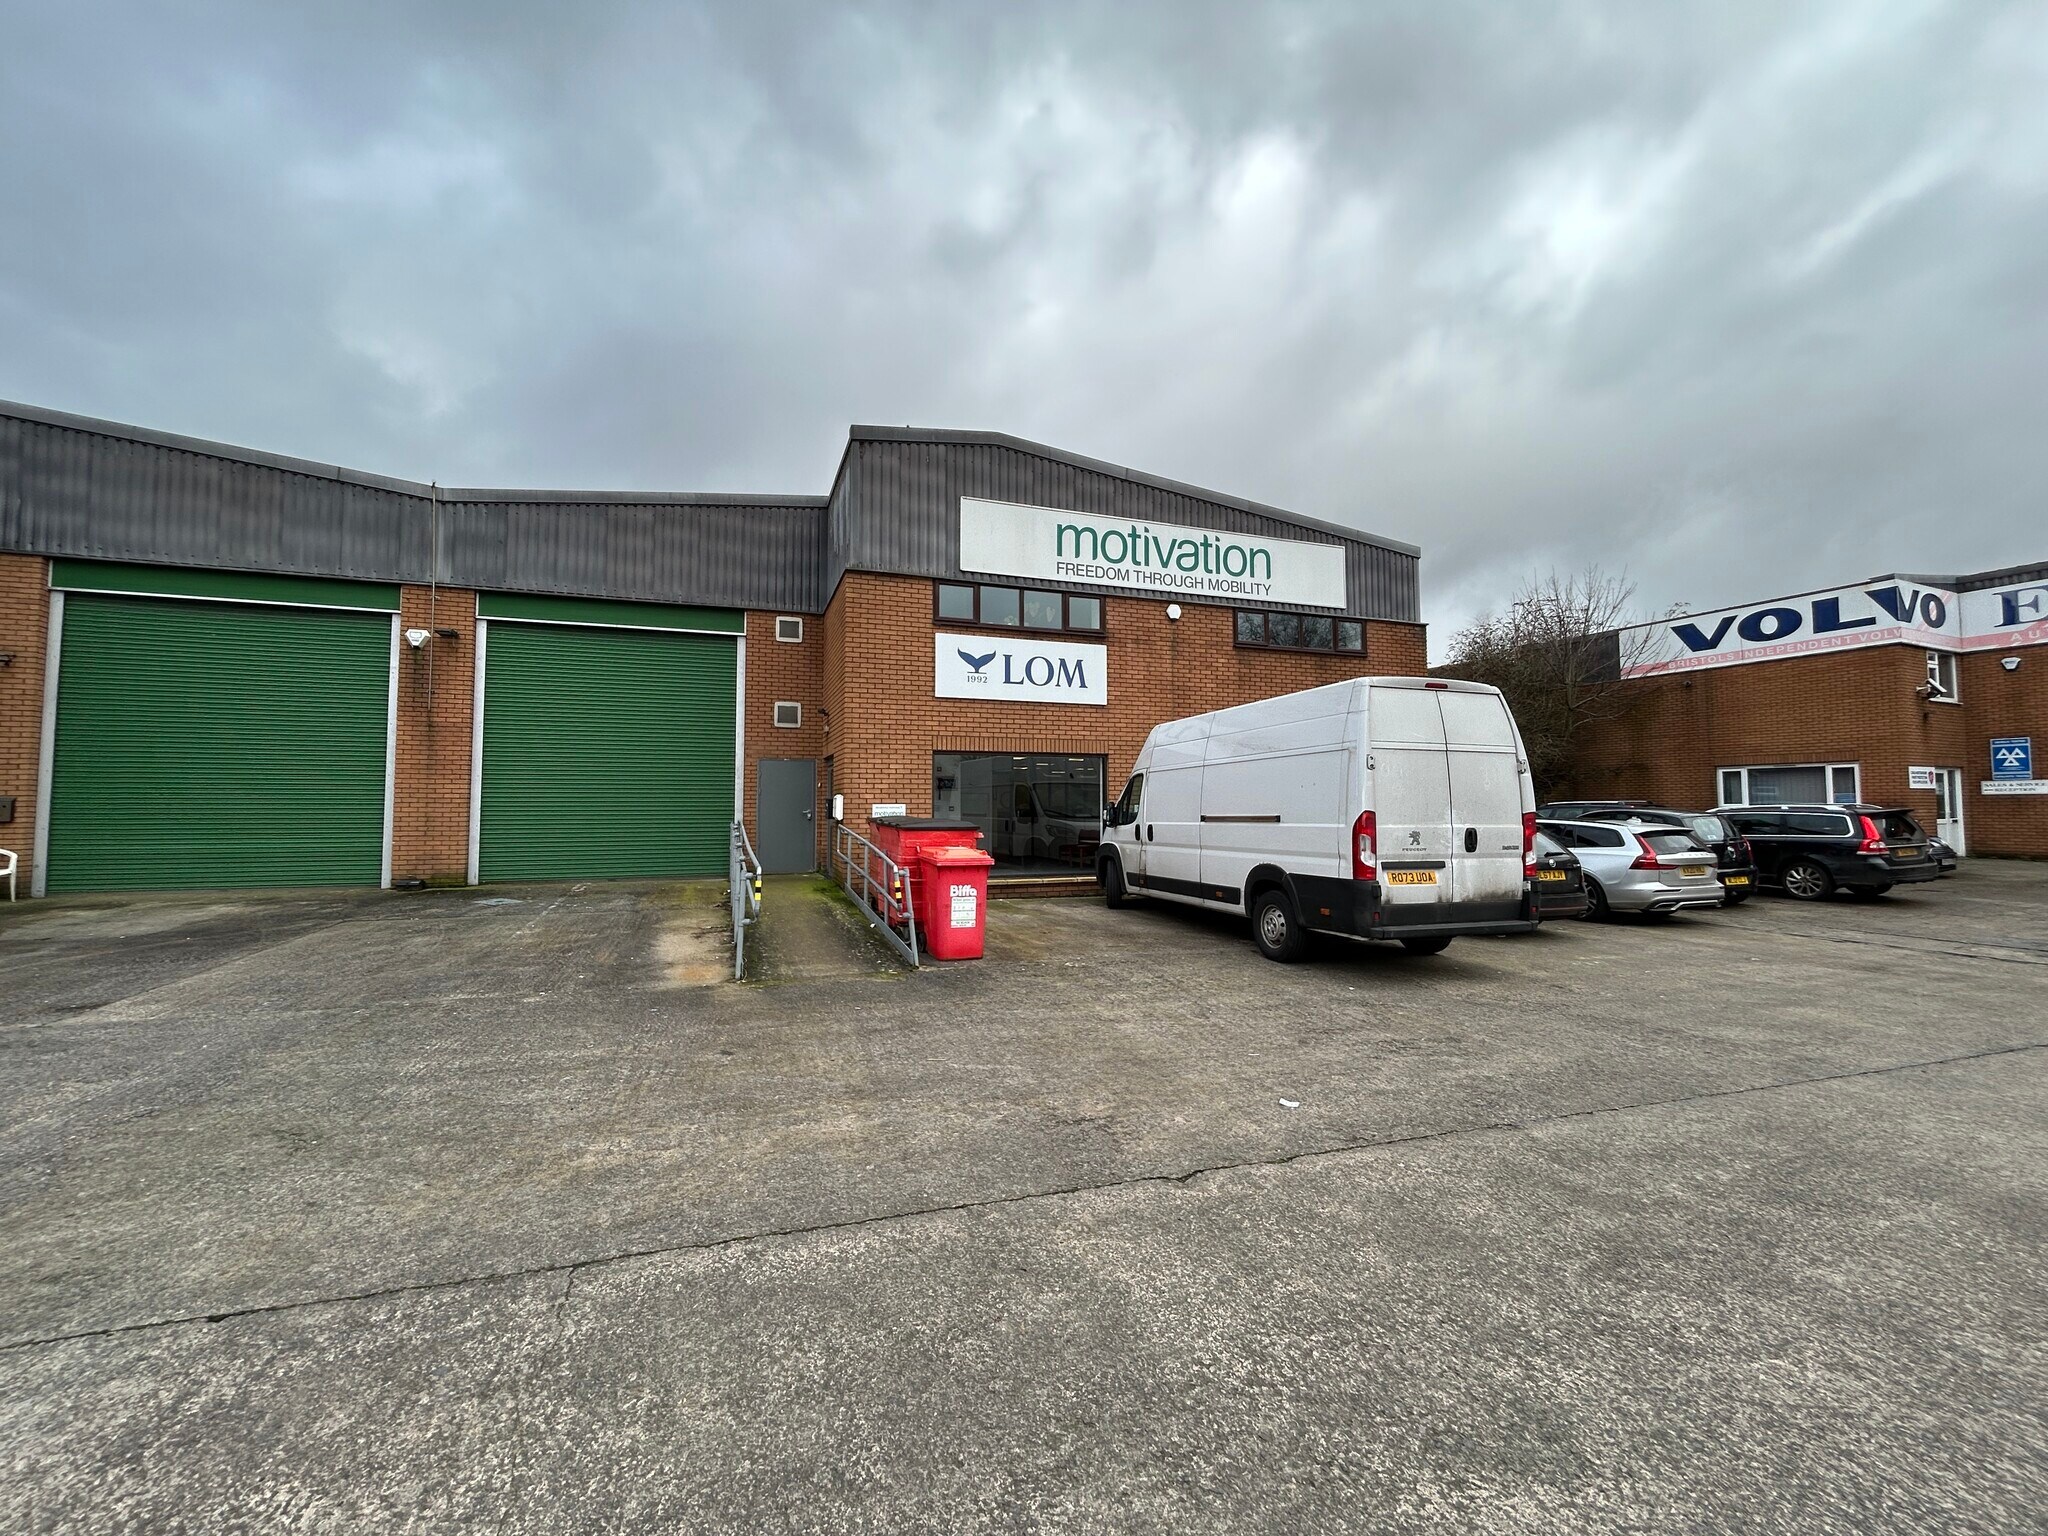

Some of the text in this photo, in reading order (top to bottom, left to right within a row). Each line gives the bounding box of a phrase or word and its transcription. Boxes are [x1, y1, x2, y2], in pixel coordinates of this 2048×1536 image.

[1056, 523, 1272, 580] motivation
[1056, 561, 1272, 596] FREEDOM THROUGH MOBILITY
[1670, 585, 1946, 653] VOLVO
[1668, 629, 1901, 669] BRISTOLS INDEPENDENT VOLV
[966, 675, 988, 684] 1992
[1002, 654, 1088, 689] LOM
[950, 884, 977, 897] Biffa
